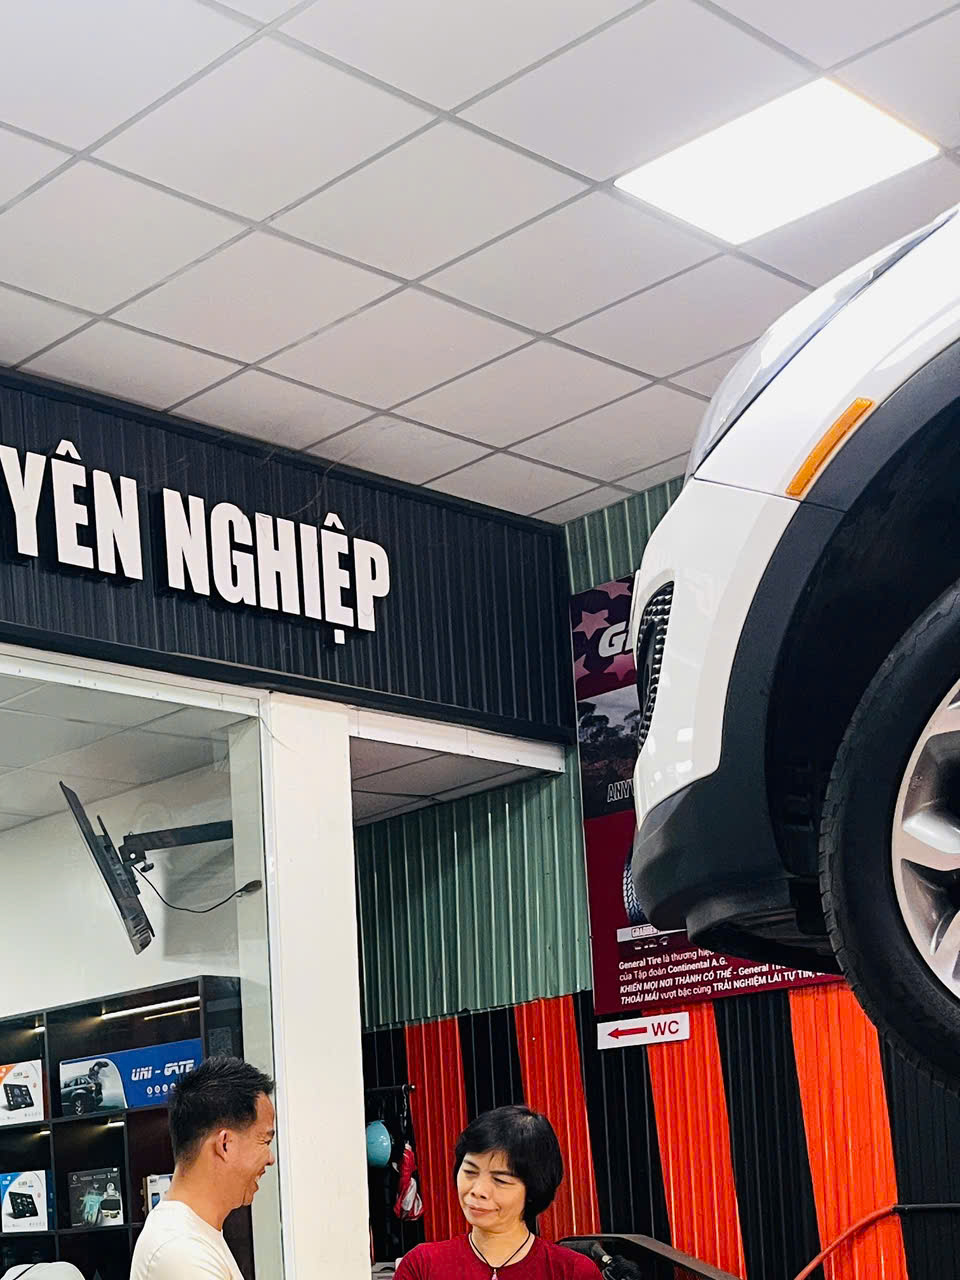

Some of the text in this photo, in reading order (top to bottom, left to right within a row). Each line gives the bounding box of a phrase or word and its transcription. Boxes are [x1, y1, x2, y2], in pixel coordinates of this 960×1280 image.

[162, 487, 391, 645] NGHIỆP
[618, 957, 646, 970] General
[647, 956, 661, 966] Tire
[662, 954, 670, 963] là
[633, 970, 648, 980] Tập
[667, 958, 710, 973] Continental
[711, 957, 728, 967] A.G.
[674, 973, 702, 986] THÀNH
[703, 970, 715, 981] CÓ
[738, 963, 769, 976] General
[693, 984, 712, 996] cùng
[733, 974, 767, 990] NGHIỆM
[651, 1020, 680, 1037] WC
